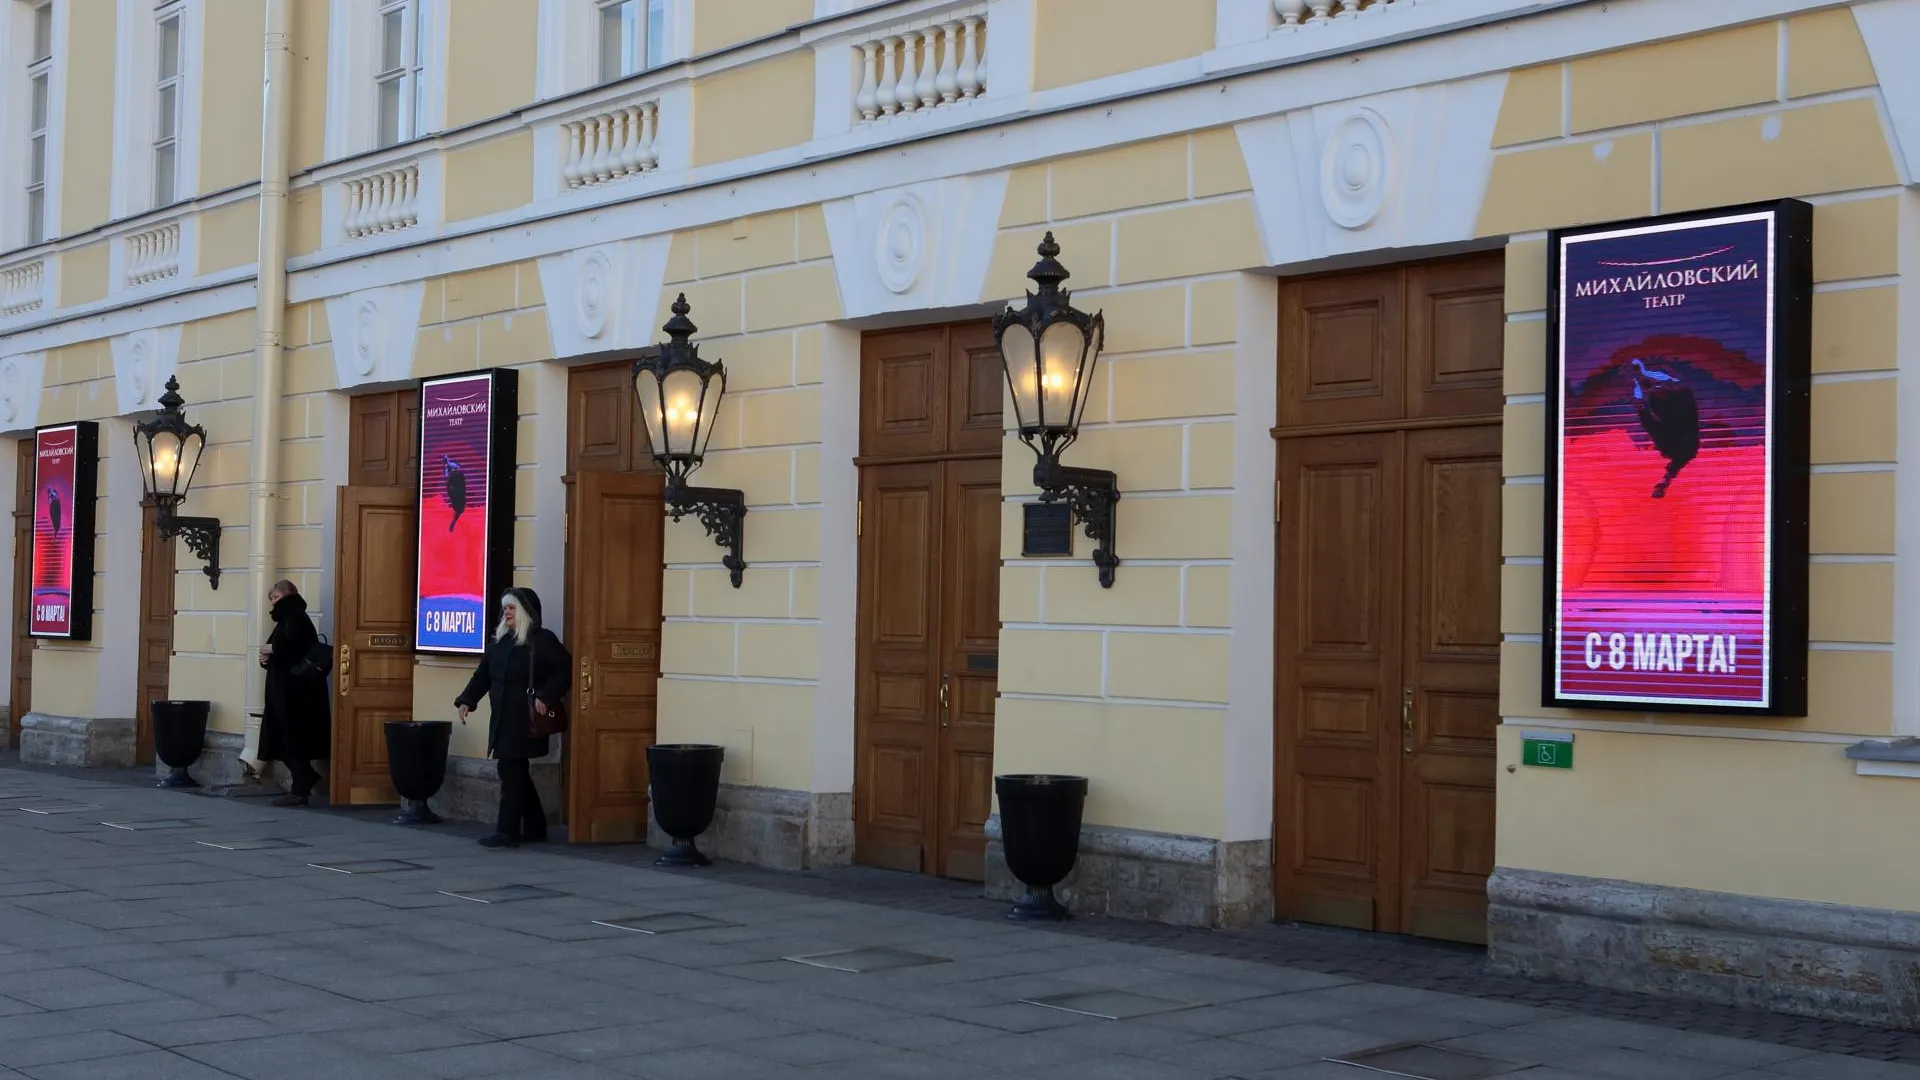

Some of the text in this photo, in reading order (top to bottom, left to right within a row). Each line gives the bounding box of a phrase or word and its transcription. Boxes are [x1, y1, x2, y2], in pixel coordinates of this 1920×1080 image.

[1575, 260, 1759, 297] МИХАЙЛОВСКИЙ
[1642, 294, 1685, 308] ТЕАТР
[426, 401, 487, 417] МИХАЙЛОВСКИЙ
[449, 417, 463, 426] ТЕАТР
[36, 605, 41, 621] С
[41, 605, 45, 621] 8
[426, 611, 475, 633] С 8 МАРТА!
[1585, 632, 1736, 673] С 8 МАРТА!
